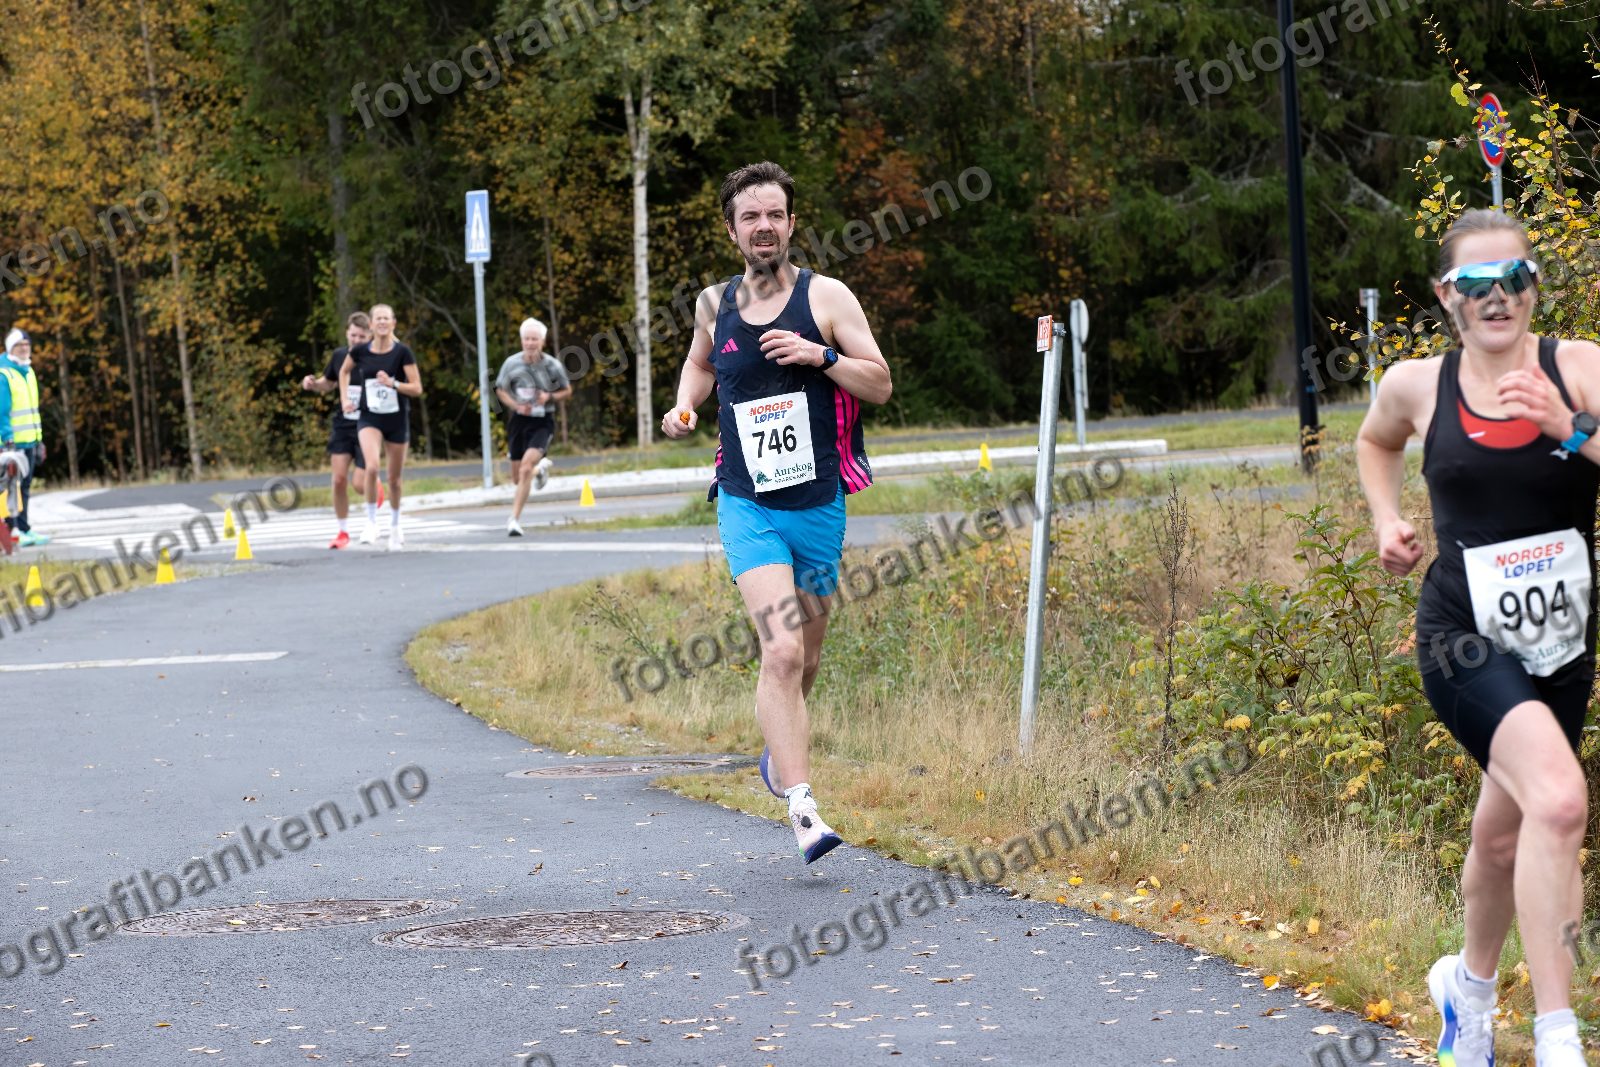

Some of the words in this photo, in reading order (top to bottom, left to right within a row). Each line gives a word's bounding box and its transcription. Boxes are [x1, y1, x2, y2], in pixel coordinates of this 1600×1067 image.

[749, 400, 794, 416] NORGES
[754, 410, 788, 424] LØPET
[752, 425, 797, 458] 746
[774, 462, 813, 477] Aurskog
[1495, 541, 1565, 567] NORGES
[1504, 557, 1556, 579] LØPET
[1498, 580, 1570, 632] 904
